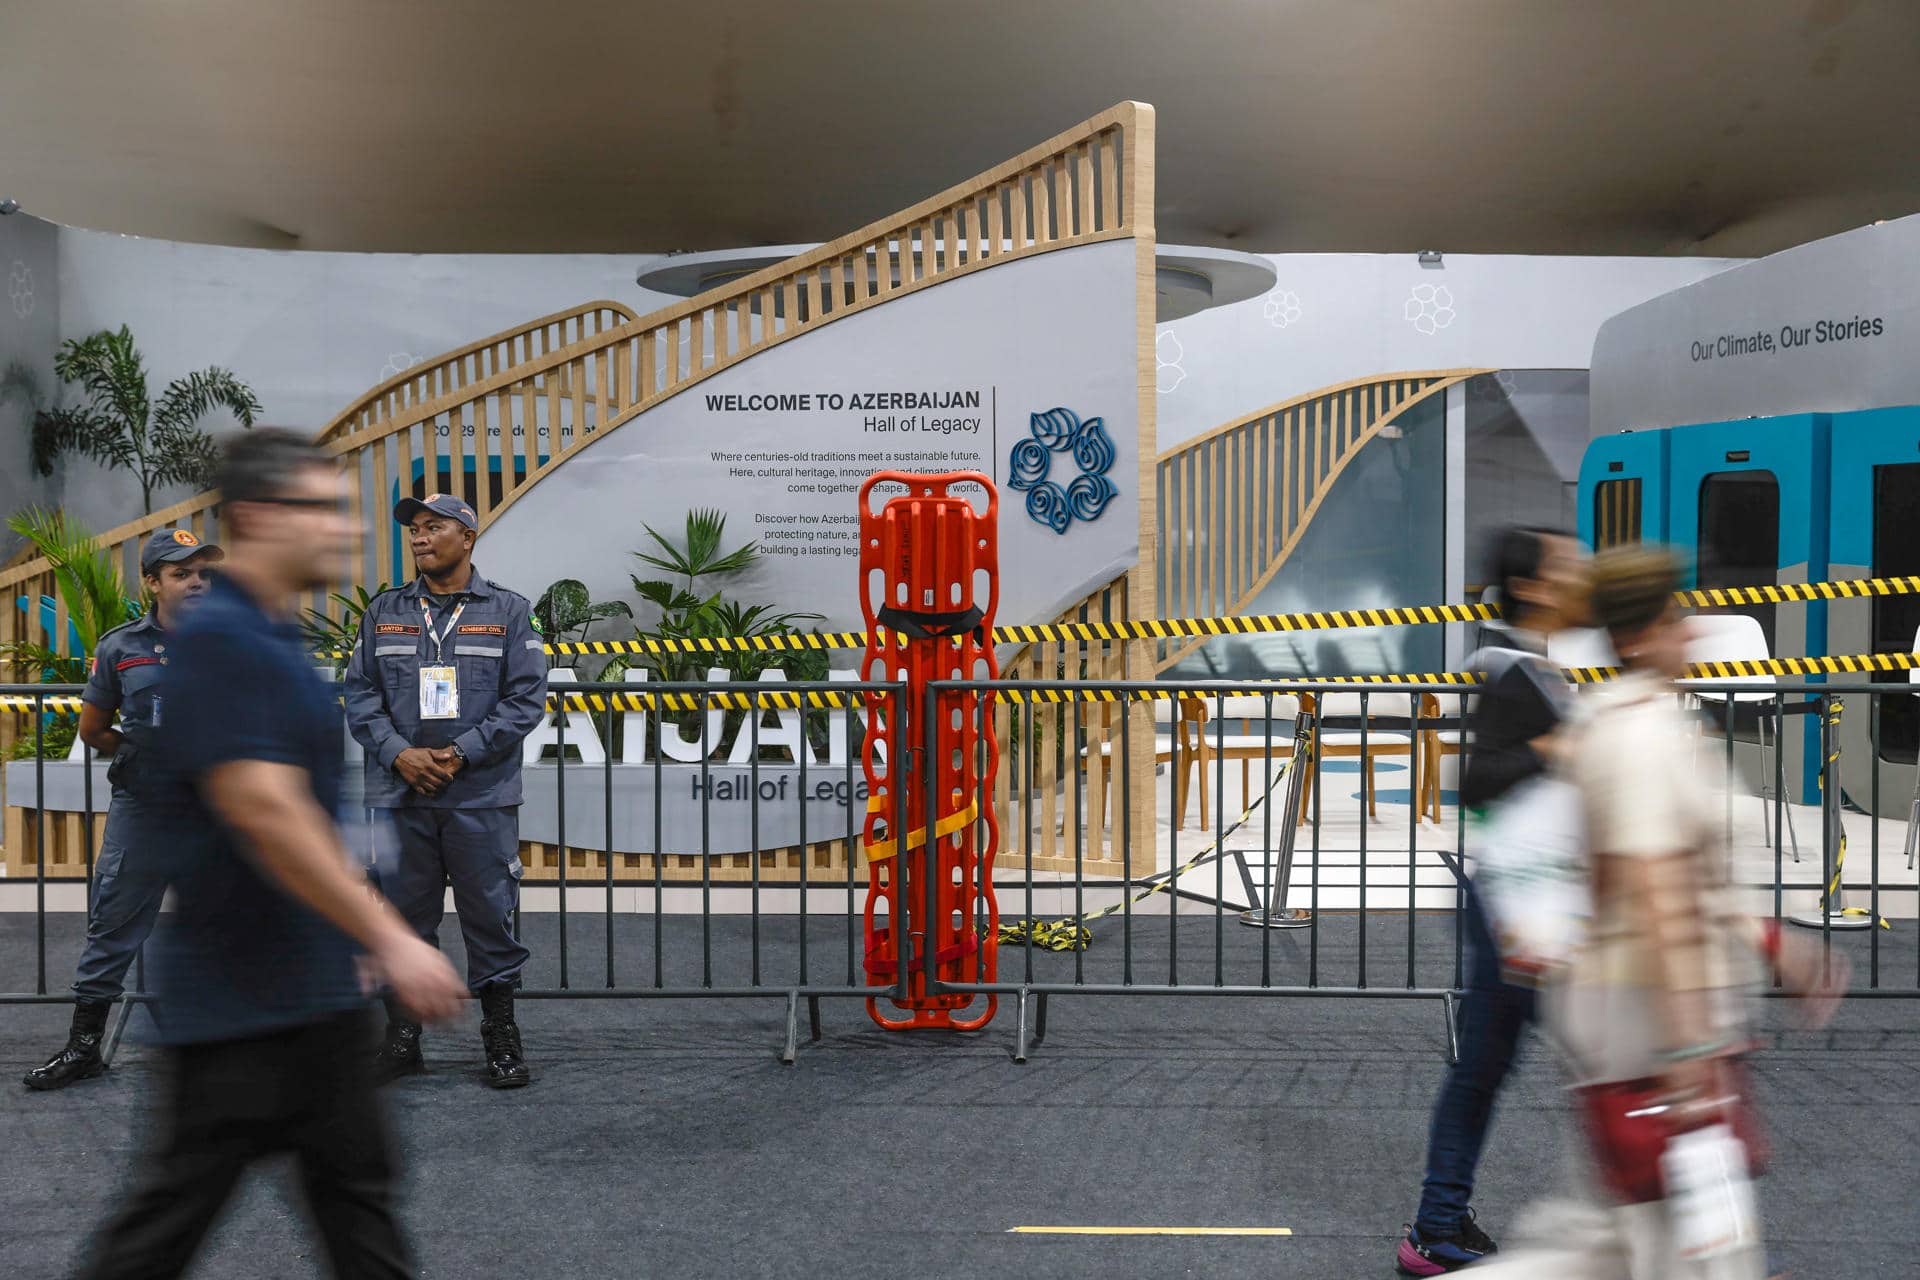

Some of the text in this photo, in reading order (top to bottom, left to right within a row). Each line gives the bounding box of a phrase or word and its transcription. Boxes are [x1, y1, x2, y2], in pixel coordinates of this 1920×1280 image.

[1691, 315, 1884, 362] Our Climate, Our Stories
[705, 391, 980, 411] WELCOME TO AZERBAIJAN
[864, 416, 981, 434] Hall of Legacy
[711, 450, 981, 462] Where centuries-old traditions meet a sustainable future.
[729, 468, 755, 477] Here,
[757, 467, 793, 477] cultural
[795, 467, 838, 478] heritage,
[787, 484, 815, 493] come
[818, 483, 859, 495] together
[873, 483, 903, 495] shape
[952, 483, 981, 493] world.
[755, 514, 798, 524] Discover
[800, 514, 819, 524] how
[765, 530, 814, 541] protecting
[816, 530, 850, 540] nature,
[760, 545, 798, 557] building
[801, 547, 807, 555] a
[809, 545, 841, 557] lasting
[692, 774, 748, 800] Hall
[758, 774, 788, 800] of
